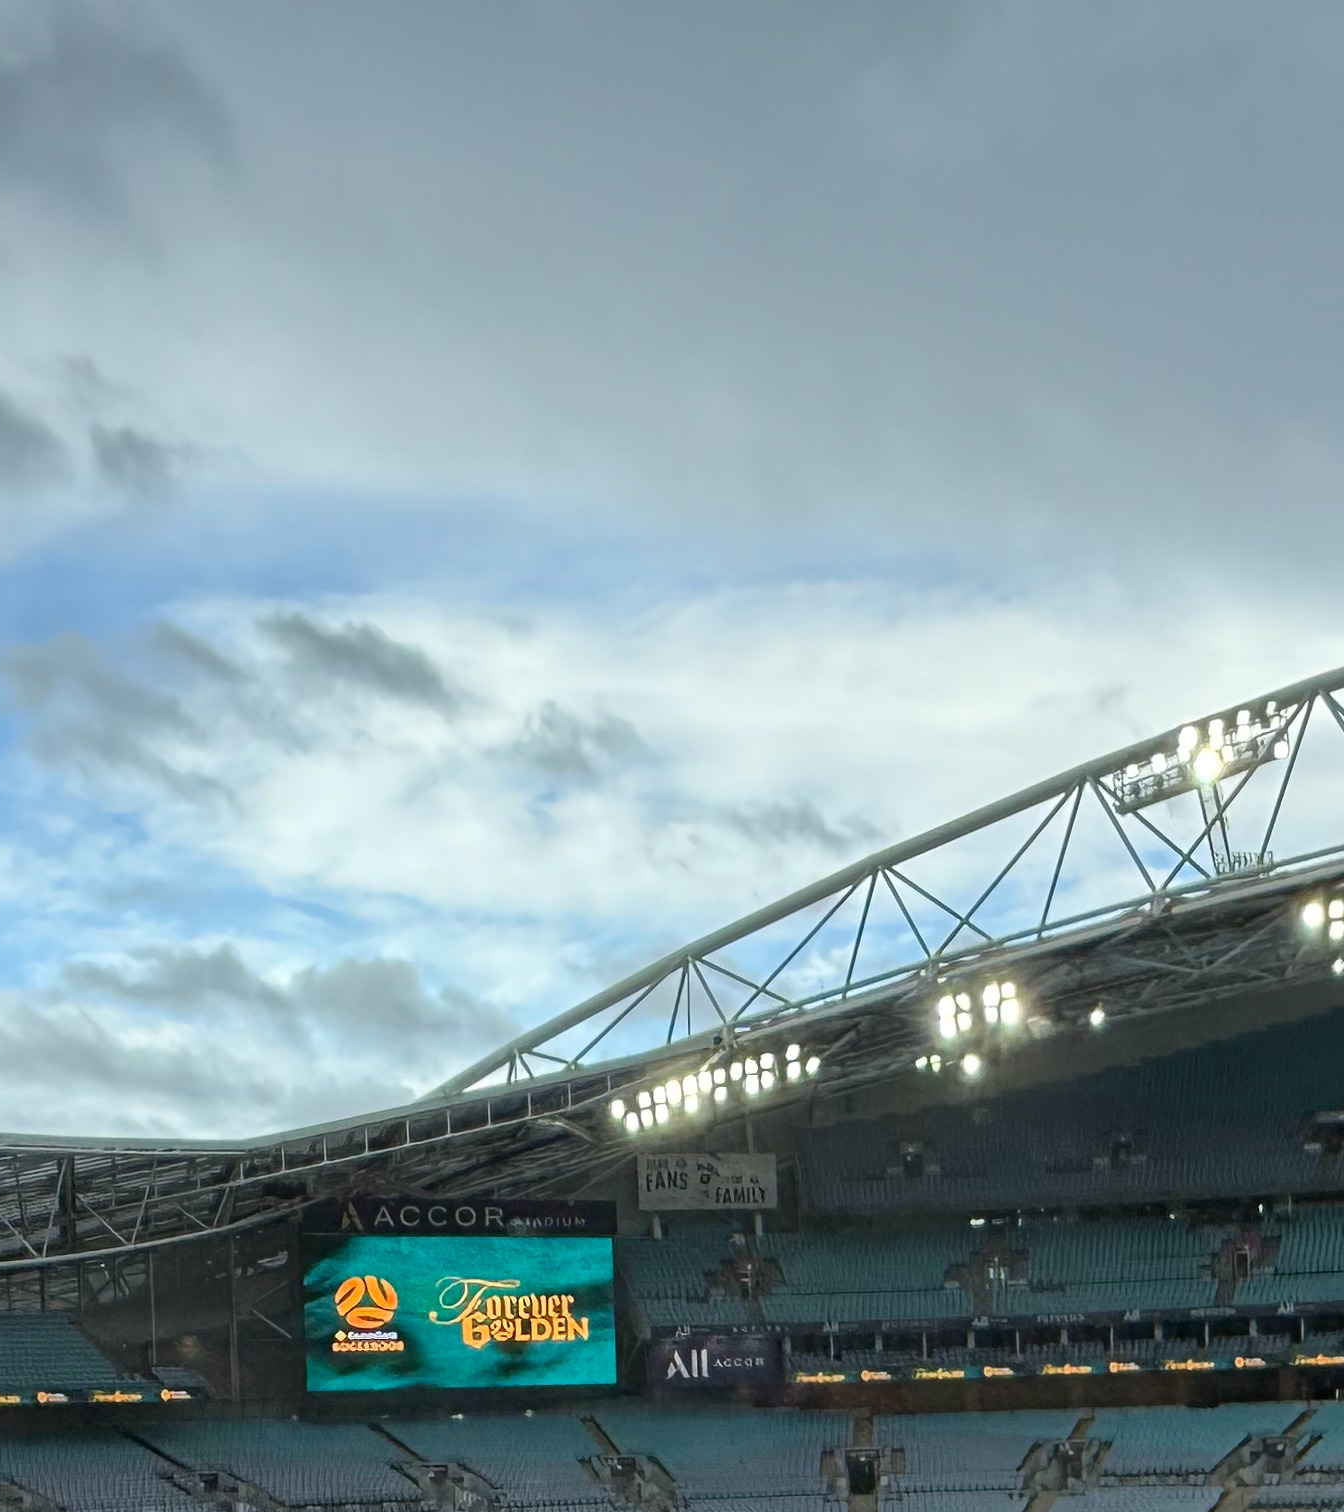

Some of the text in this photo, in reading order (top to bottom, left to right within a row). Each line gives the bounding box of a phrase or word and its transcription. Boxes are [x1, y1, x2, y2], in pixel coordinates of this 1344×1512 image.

[646, 1171, 689, 1193] FANS
[373, 1205, 505, 1228] ACCOR
[428, 1276, 576, 1325] Forever
[461, 1312, 590, 1350] GOLDEN
[713, 1357, 765, 1368] ACCOR
